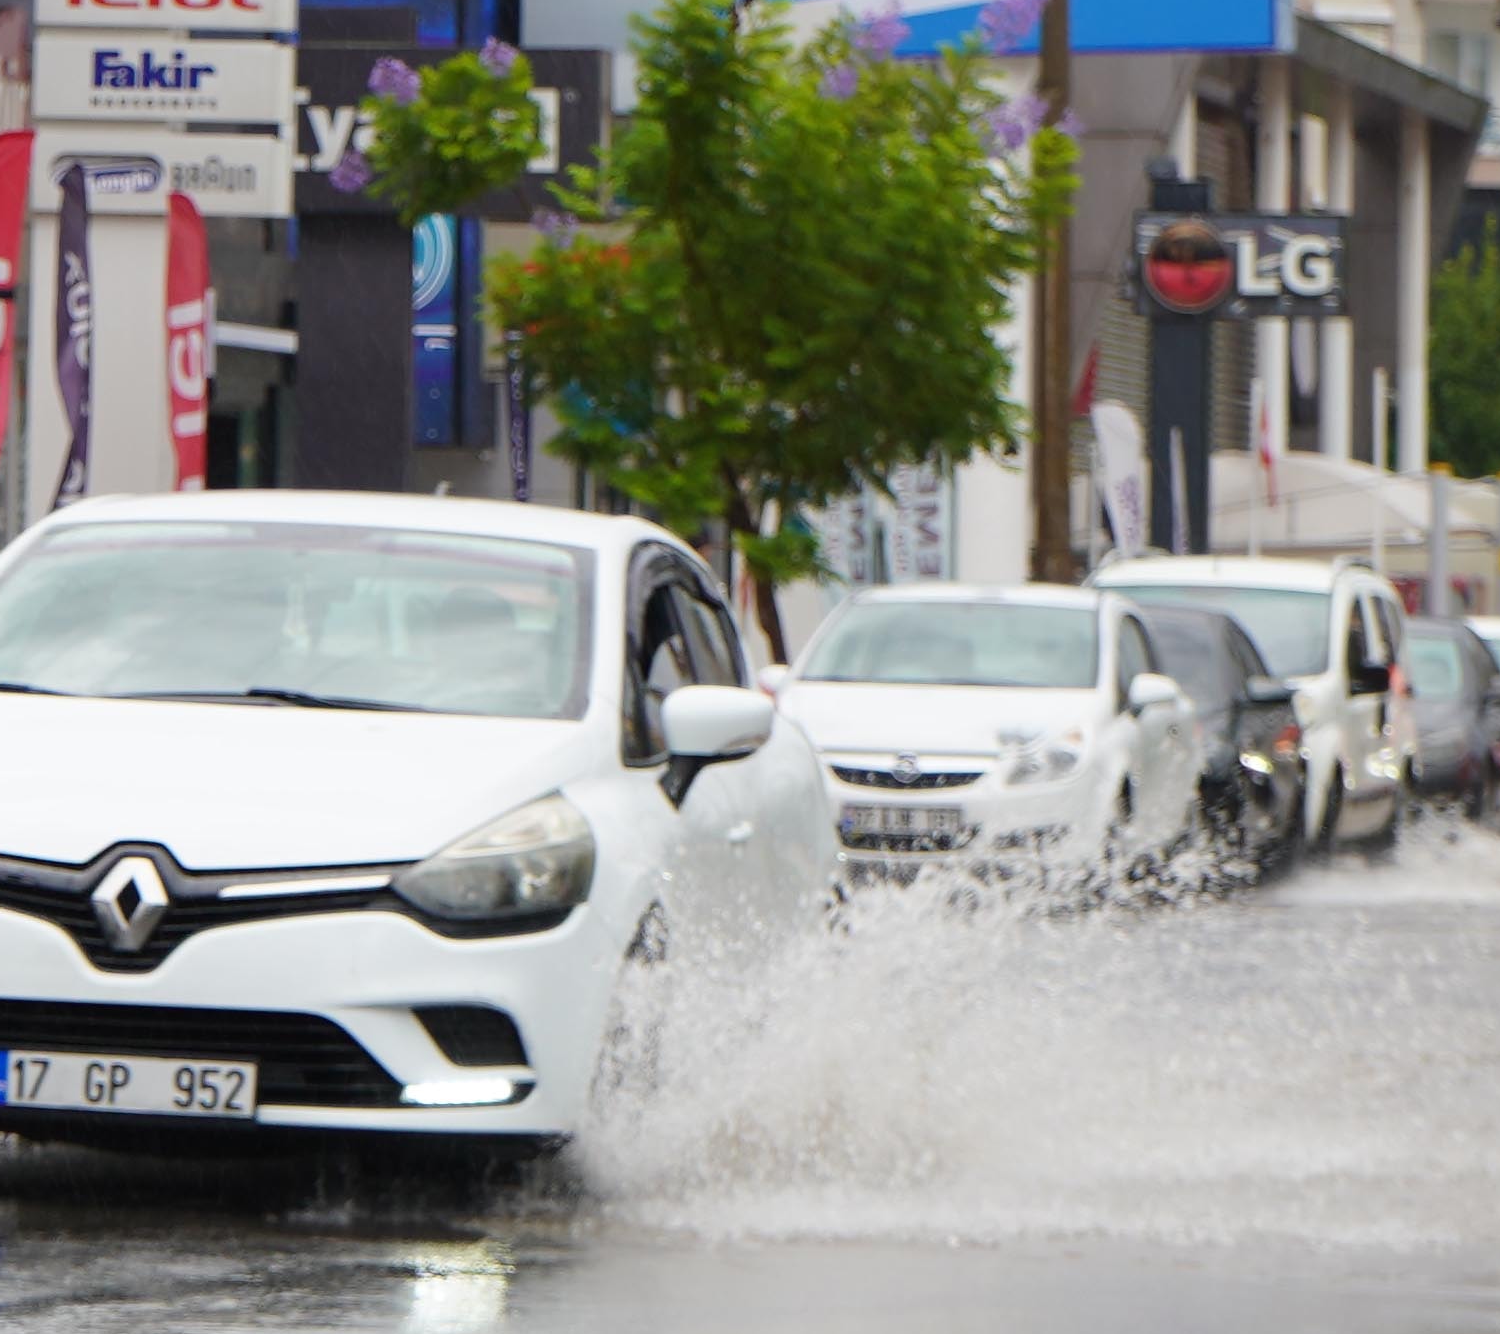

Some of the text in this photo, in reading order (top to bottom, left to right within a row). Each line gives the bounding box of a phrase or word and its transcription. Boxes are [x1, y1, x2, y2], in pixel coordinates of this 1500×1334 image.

[92, 50, 217, 89] Fakir
[1235, 234, 1337, 296] LG
[14, 1058, 247, 1111] 17 GP 952
